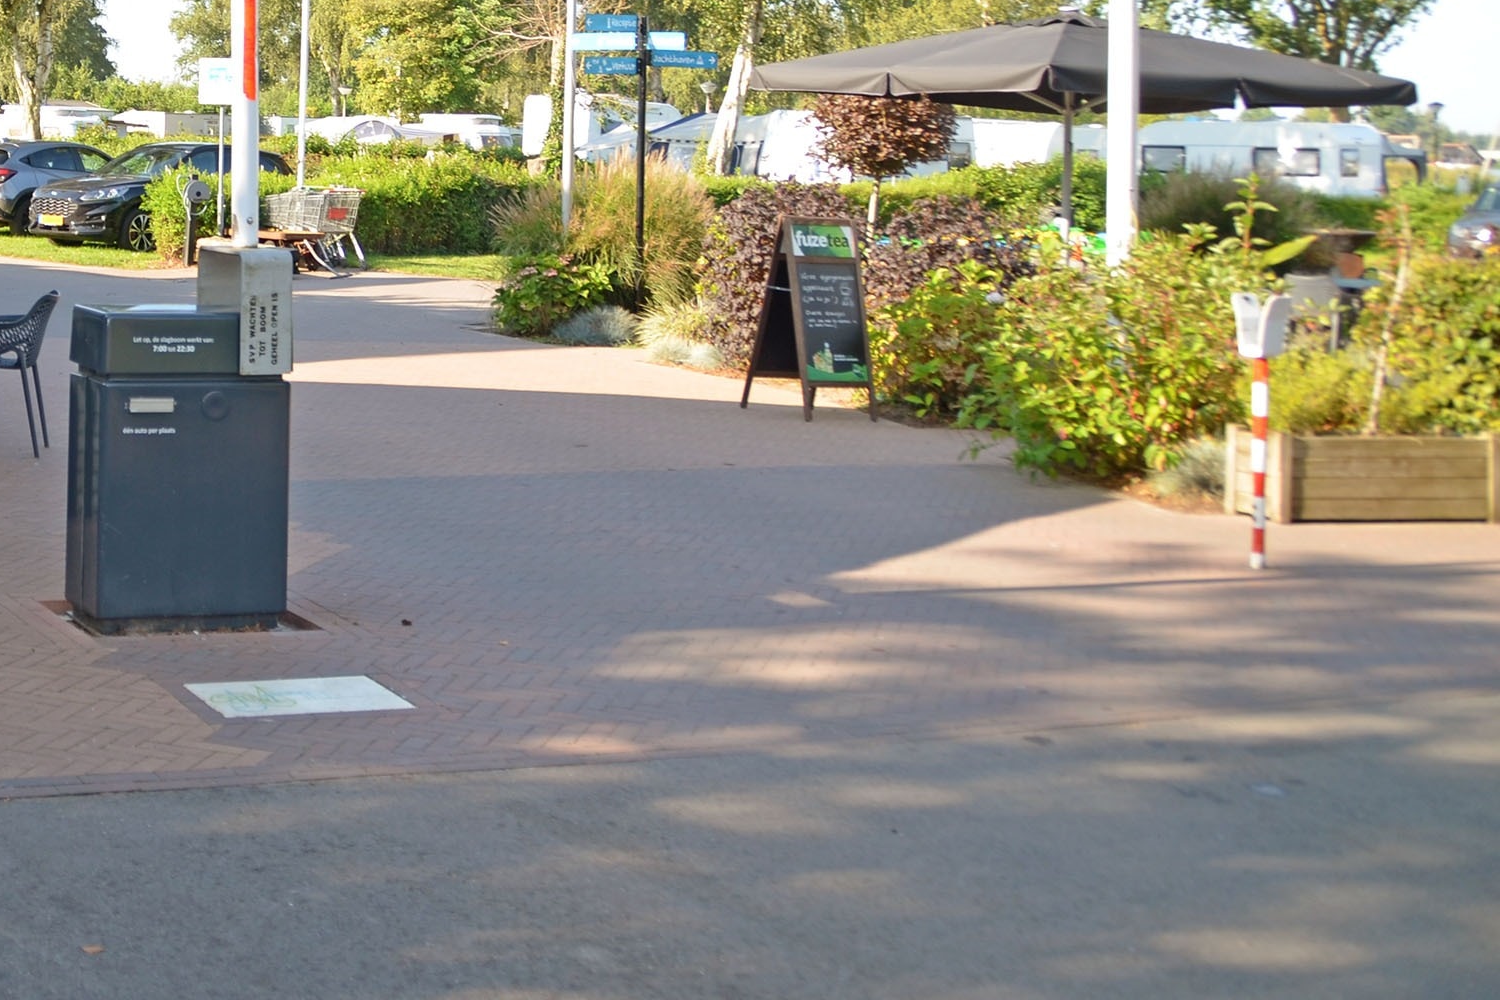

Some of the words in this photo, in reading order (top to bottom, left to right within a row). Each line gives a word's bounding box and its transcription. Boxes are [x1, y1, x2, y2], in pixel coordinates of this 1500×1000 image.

[271, 292, 278, 302] IS
[249, 295, 257, 338] WACHTEN
[160, 336, 186, 345] slagboom
[186, 336, 203, 344] werkt
[152, 345, 167, 353] 7:00
[158, 427, 176, 435] plaats
